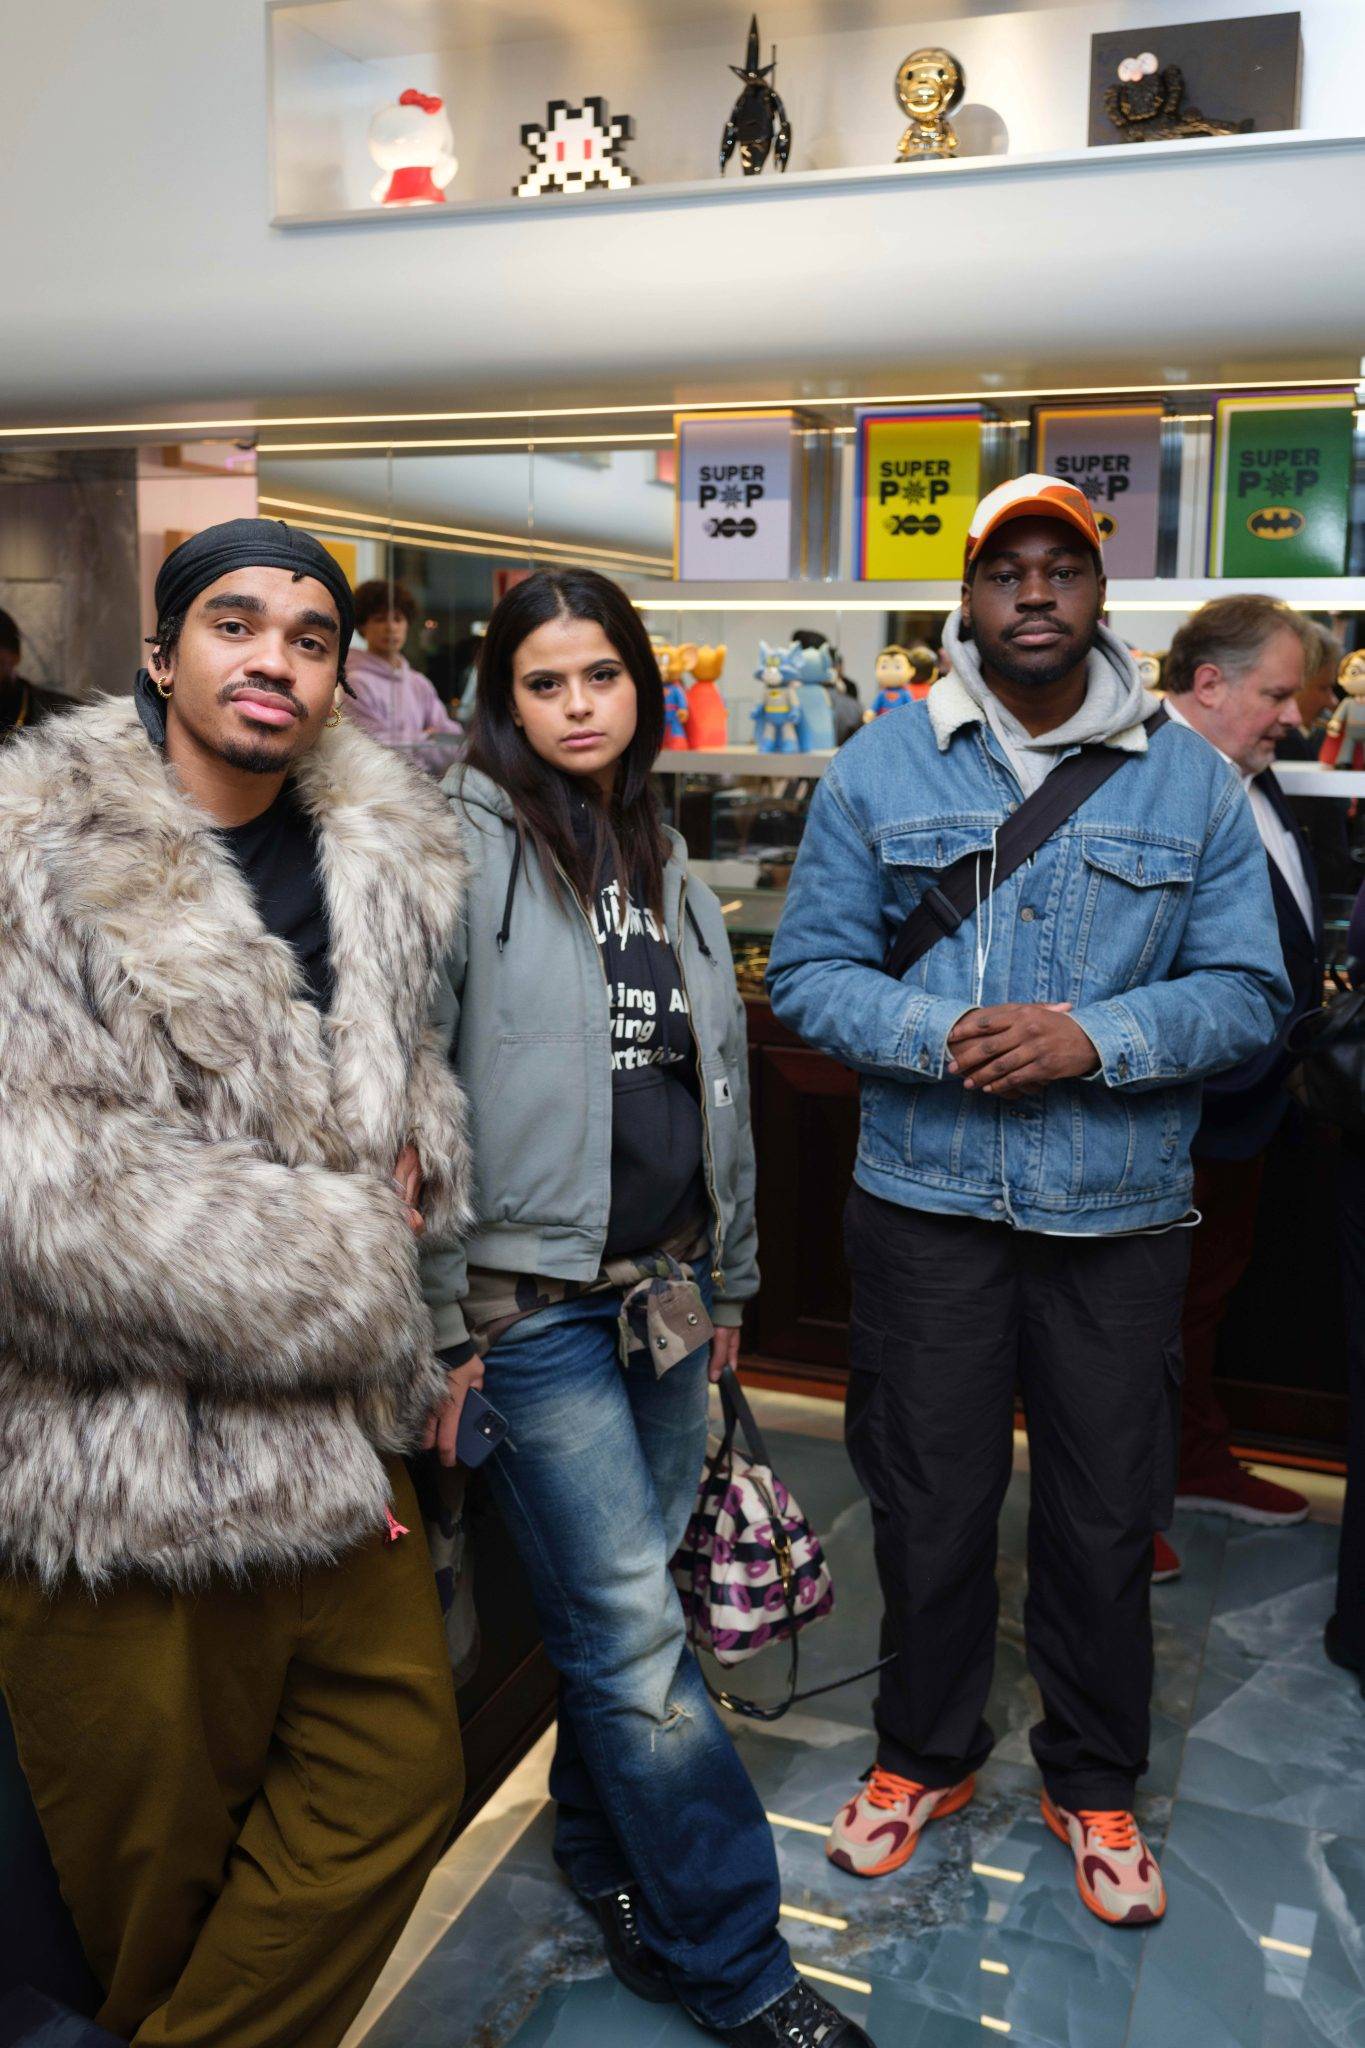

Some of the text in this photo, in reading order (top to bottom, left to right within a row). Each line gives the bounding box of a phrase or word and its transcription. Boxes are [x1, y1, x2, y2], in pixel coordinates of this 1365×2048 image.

[1055, 454, 1131, 473] SUPER
[1240, 448, 1320, 468] SUPER
[700, 465, 765, 481] SUPER
[880, 460, 951, 477] SUPER
